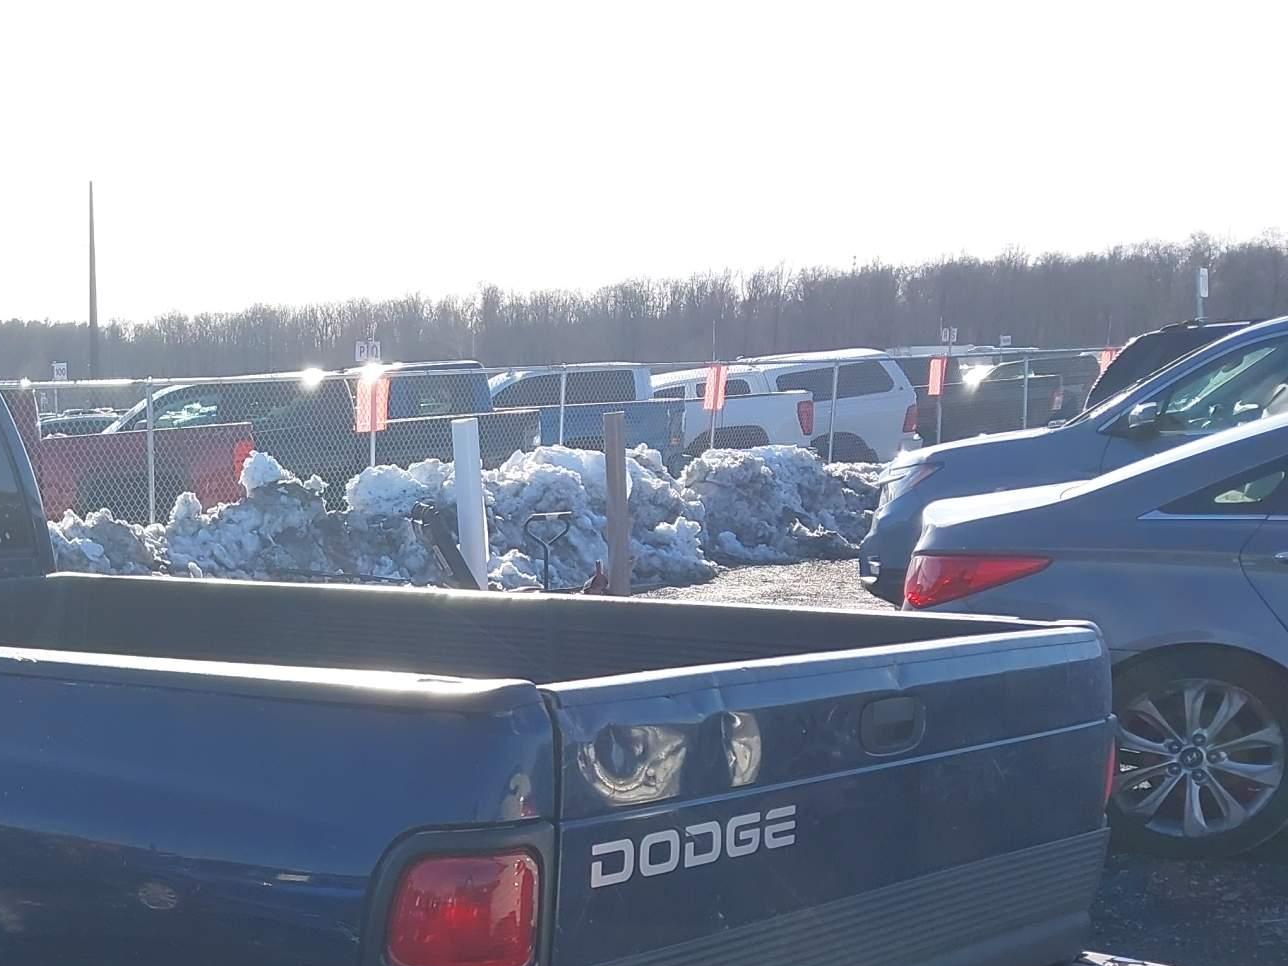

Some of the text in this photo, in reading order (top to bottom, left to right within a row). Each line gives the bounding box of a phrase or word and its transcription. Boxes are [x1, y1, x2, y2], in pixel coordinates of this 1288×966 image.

[359, 345, 365, 358] P
[55, 367, 66, 377] 100
[590, 805, 797, 889] DODGE
